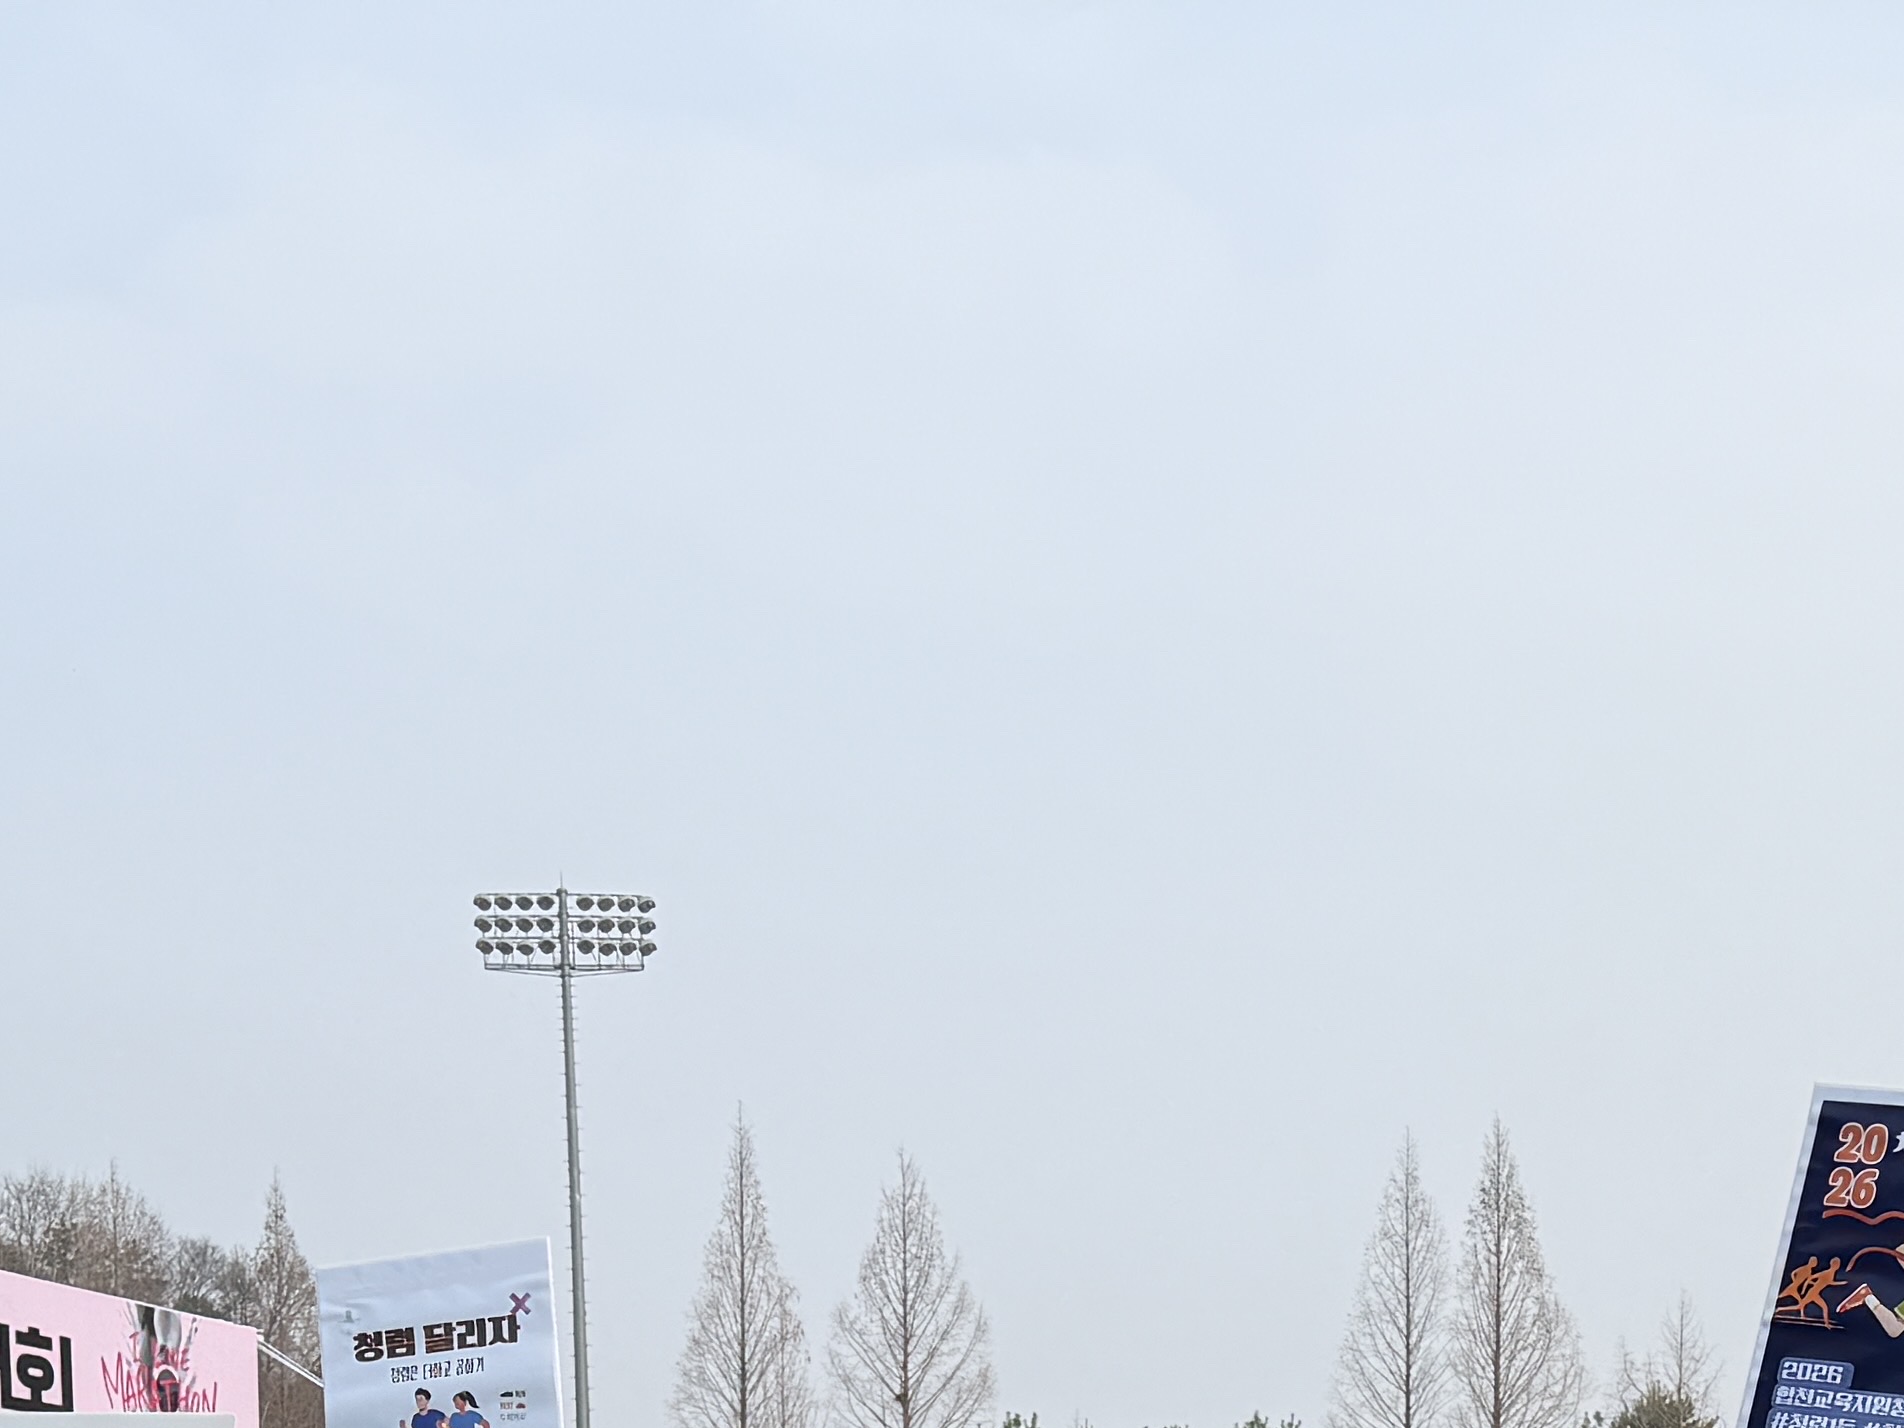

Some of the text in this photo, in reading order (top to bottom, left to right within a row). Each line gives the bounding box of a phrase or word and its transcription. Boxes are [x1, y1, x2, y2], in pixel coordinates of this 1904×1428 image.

[1833, 1121, 1889, 1165] 20
[1823, 1166, 1878, 1208] 26
[353, 1314, 520, 1362] 청렴 달리자
[1781, 1361, 1844, 1384] 2026
